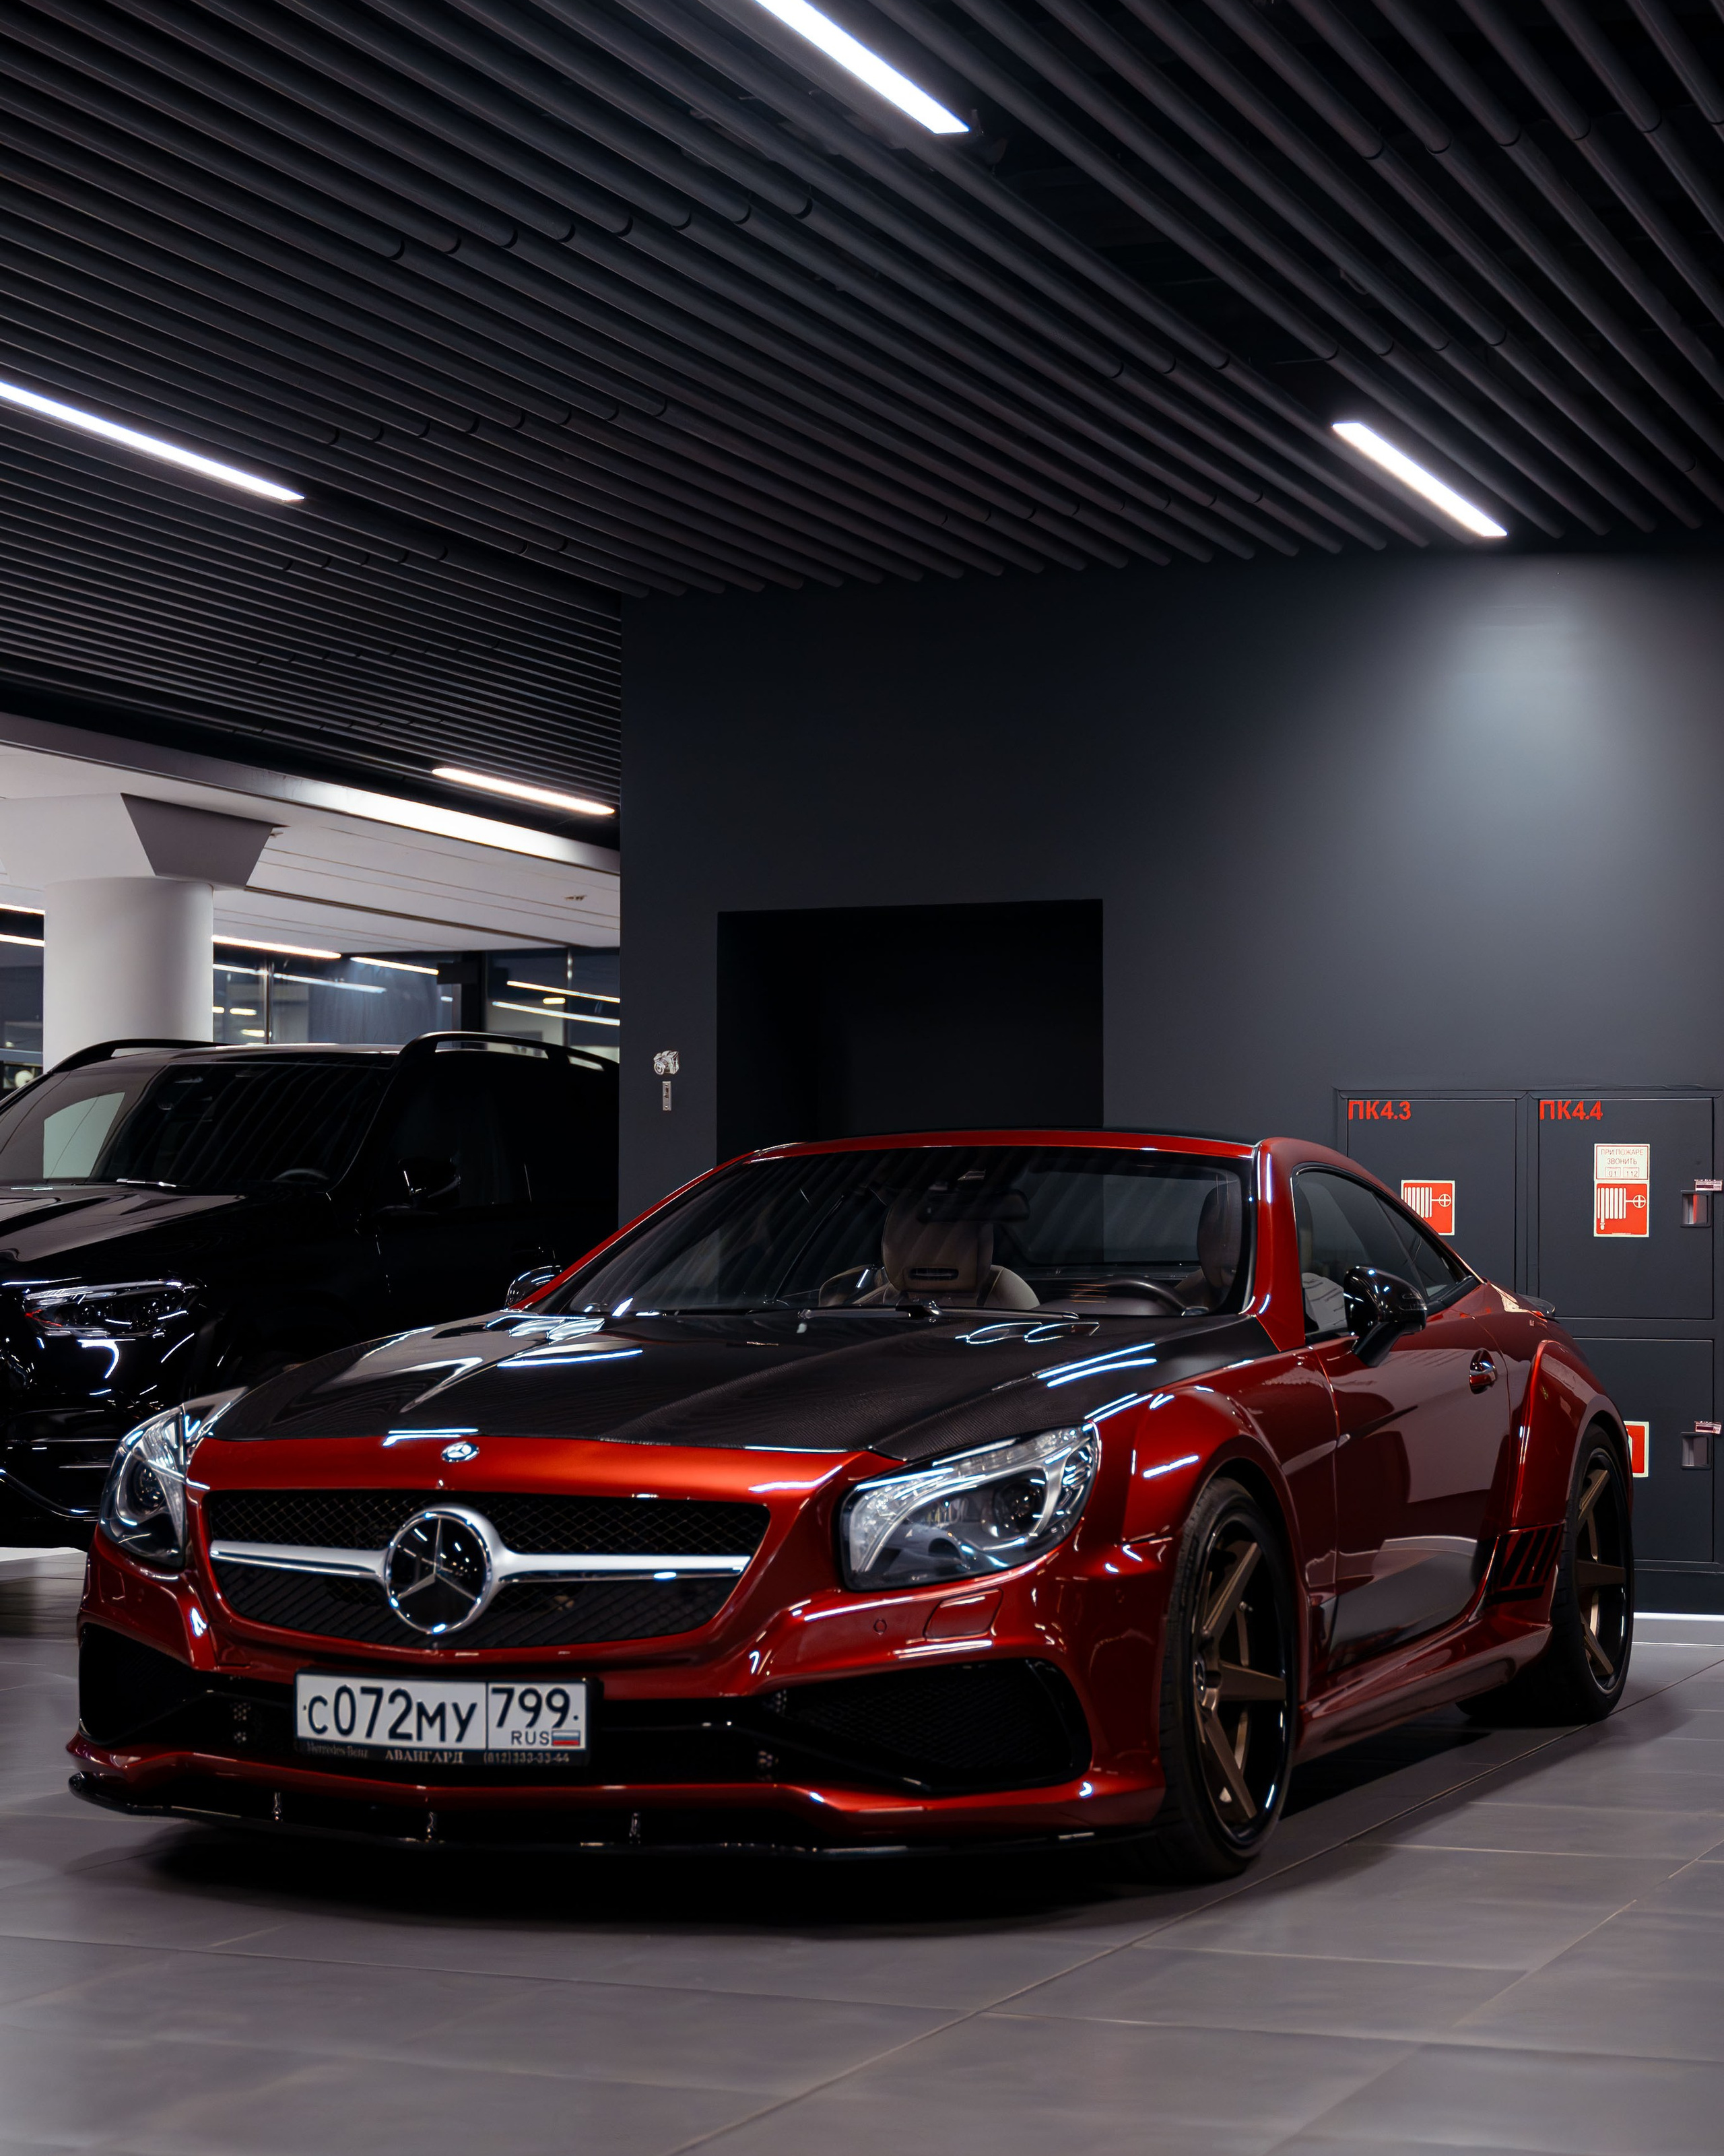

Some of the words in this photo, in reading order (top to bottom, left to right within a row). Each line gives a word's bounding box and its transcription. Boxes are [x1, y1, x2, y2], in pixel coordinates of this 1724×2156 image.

[1348, 1101, 1412, 1120] ПК4.3
[1539, 1101, 1603, 1120] ПК4.4
[492, 1687, 571, 1729] 799
[511, 1730, 550, 1746] RUS
[385, 1750, 465, 1765] АВАНГАРД
